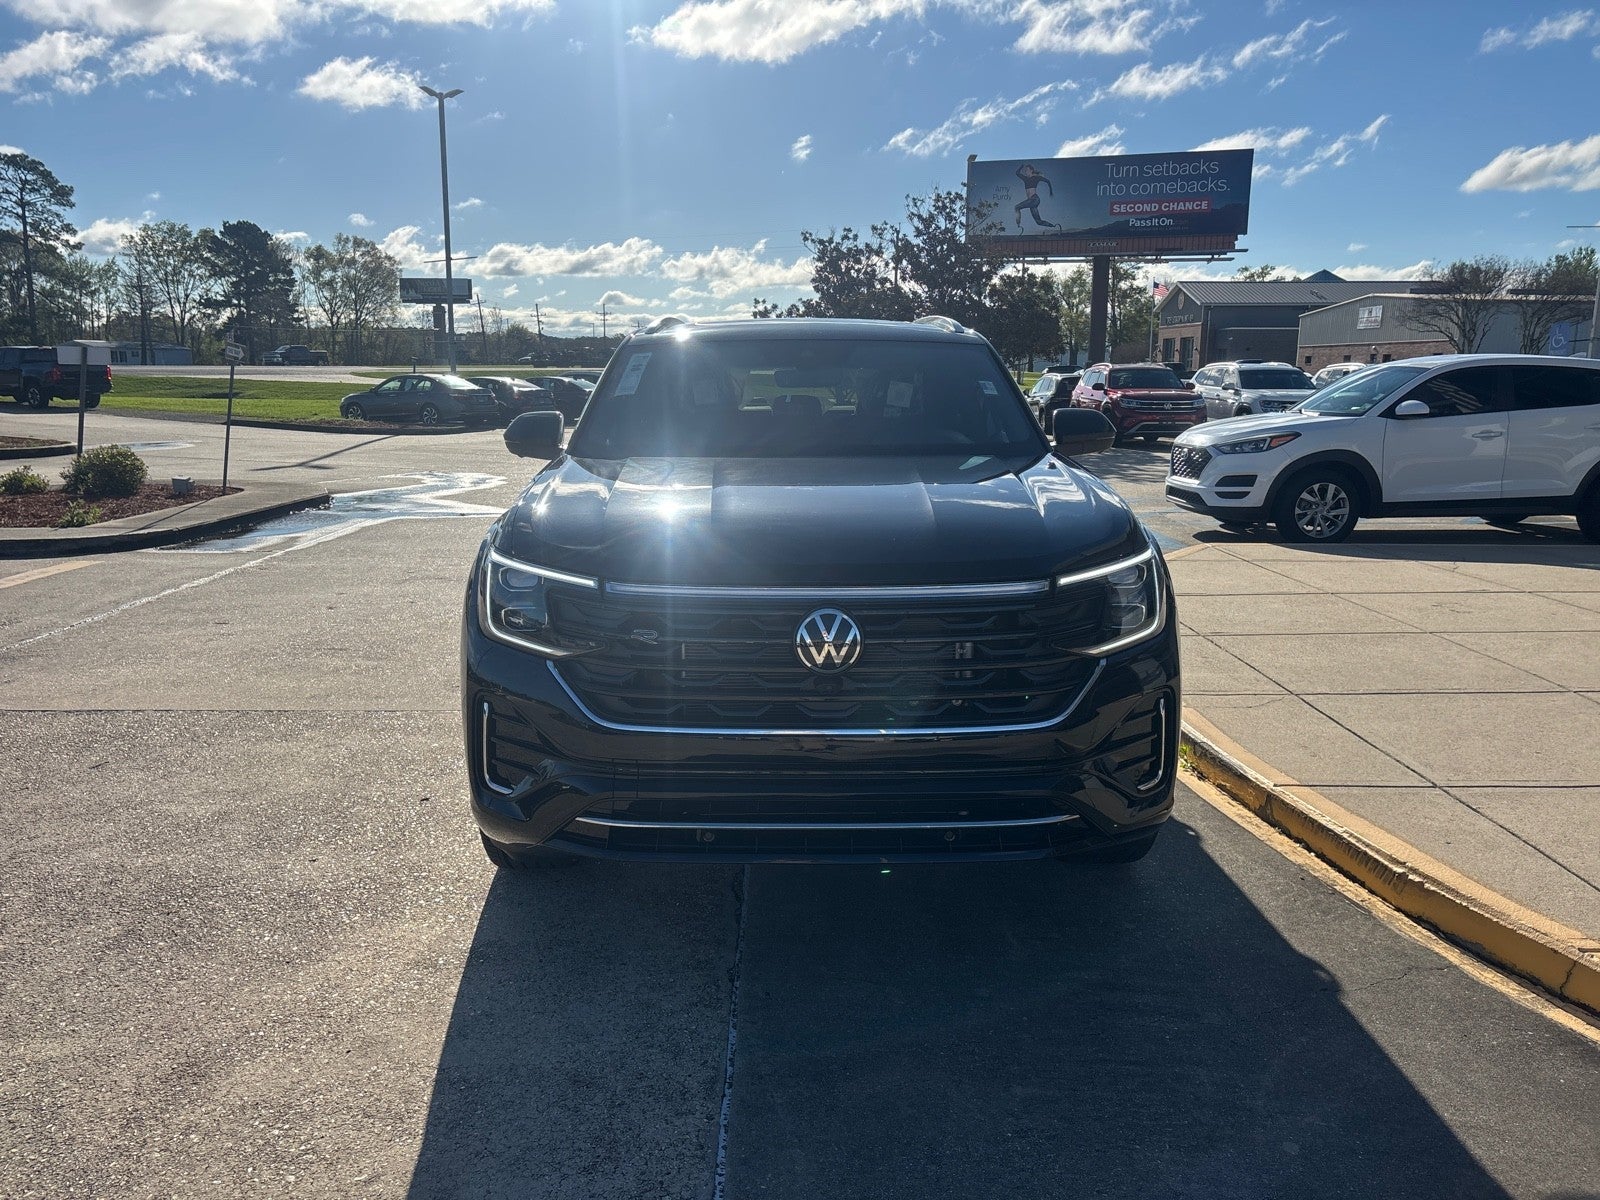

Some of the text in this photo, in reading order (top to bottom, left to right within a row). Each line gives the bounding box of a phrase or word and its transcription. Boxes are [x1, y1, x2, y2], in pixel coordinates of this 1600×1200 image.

[1105, 159, 1220, 178] Turn setbacks
[1096, 177, 1231, 196] into comebacks.
[1112, 201, 1208, 213] SECOND CHANCE
